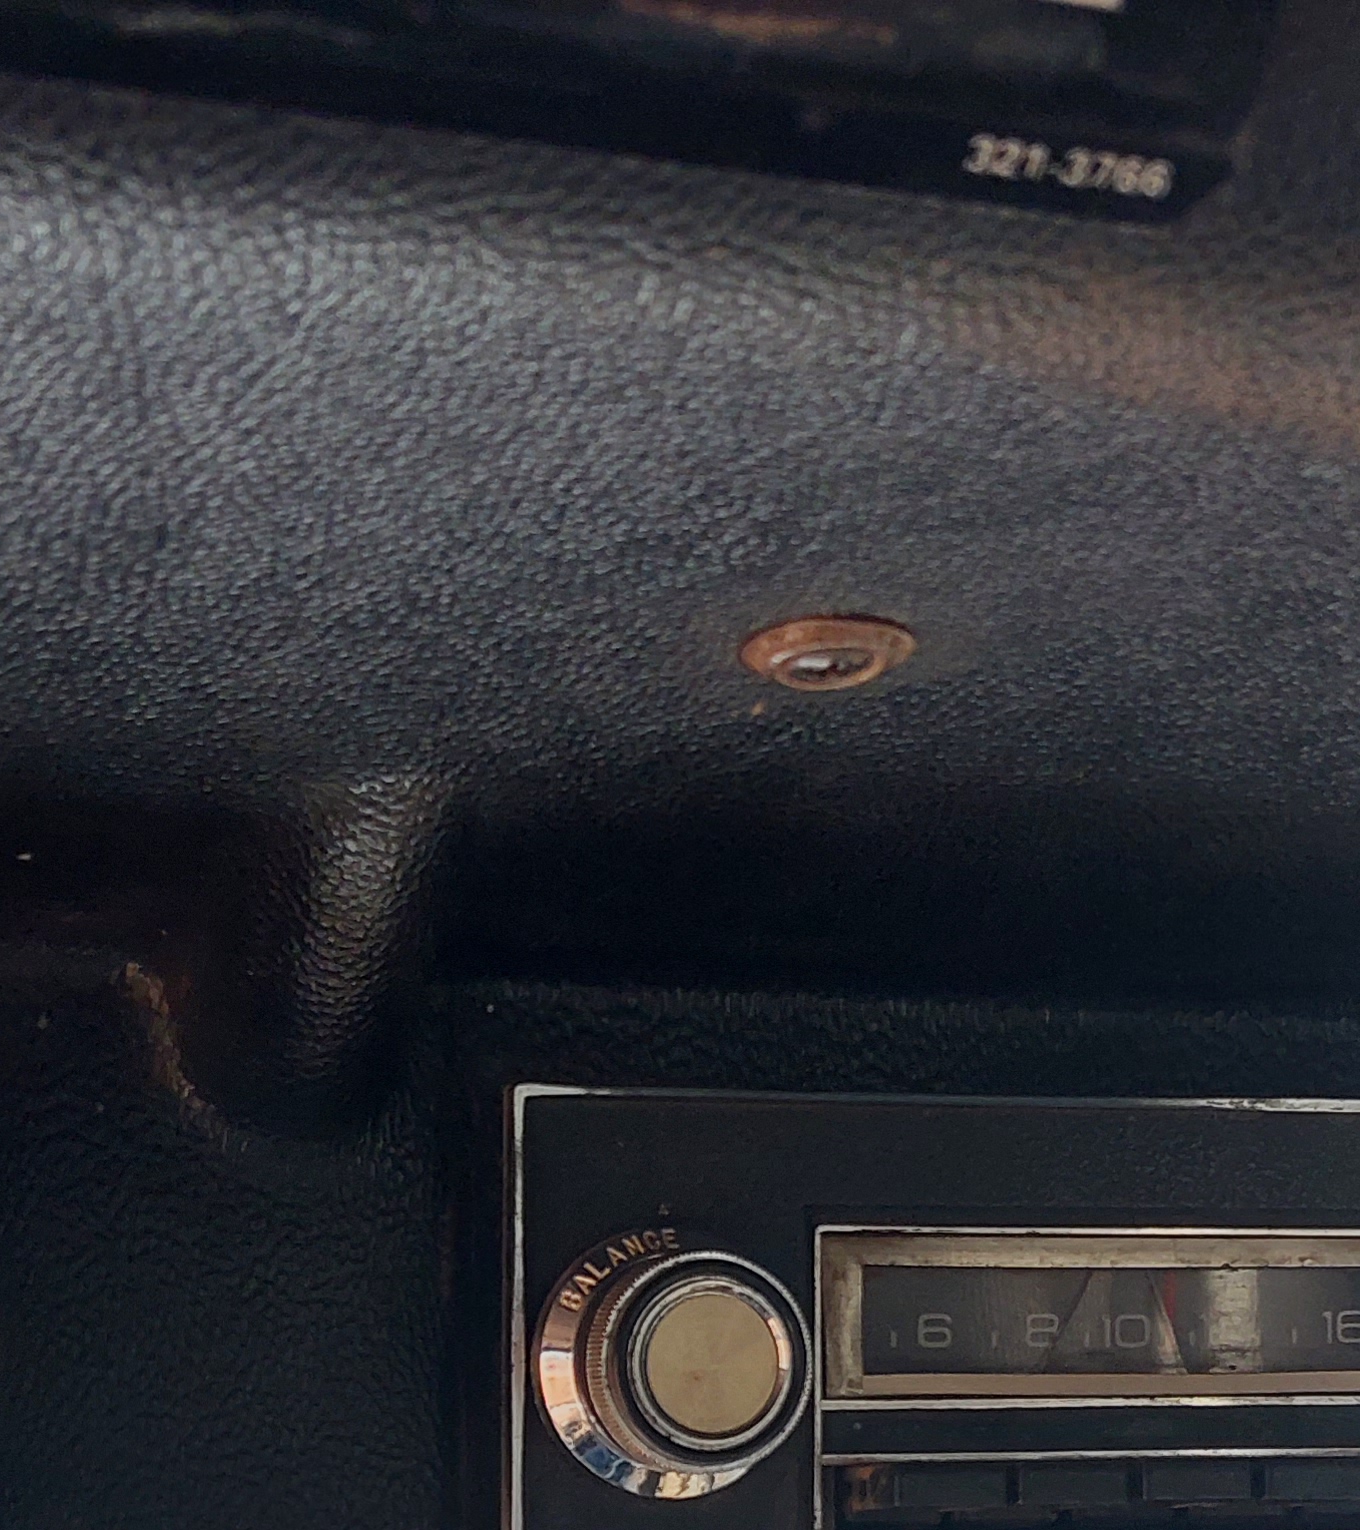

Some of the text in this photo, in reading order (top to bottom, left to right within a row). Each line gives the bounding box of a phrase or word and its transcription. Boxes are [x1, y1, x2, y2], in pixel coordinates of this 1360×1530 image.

[963, 132, 1174, 198] 321-3766
[559, 1227, 680, 1312] BALANCE
[916, 1313, 953, 1348] 6
[1026, 1313, 1061, 1348] 8
[1102, 1313, 1152, 1349] 10
